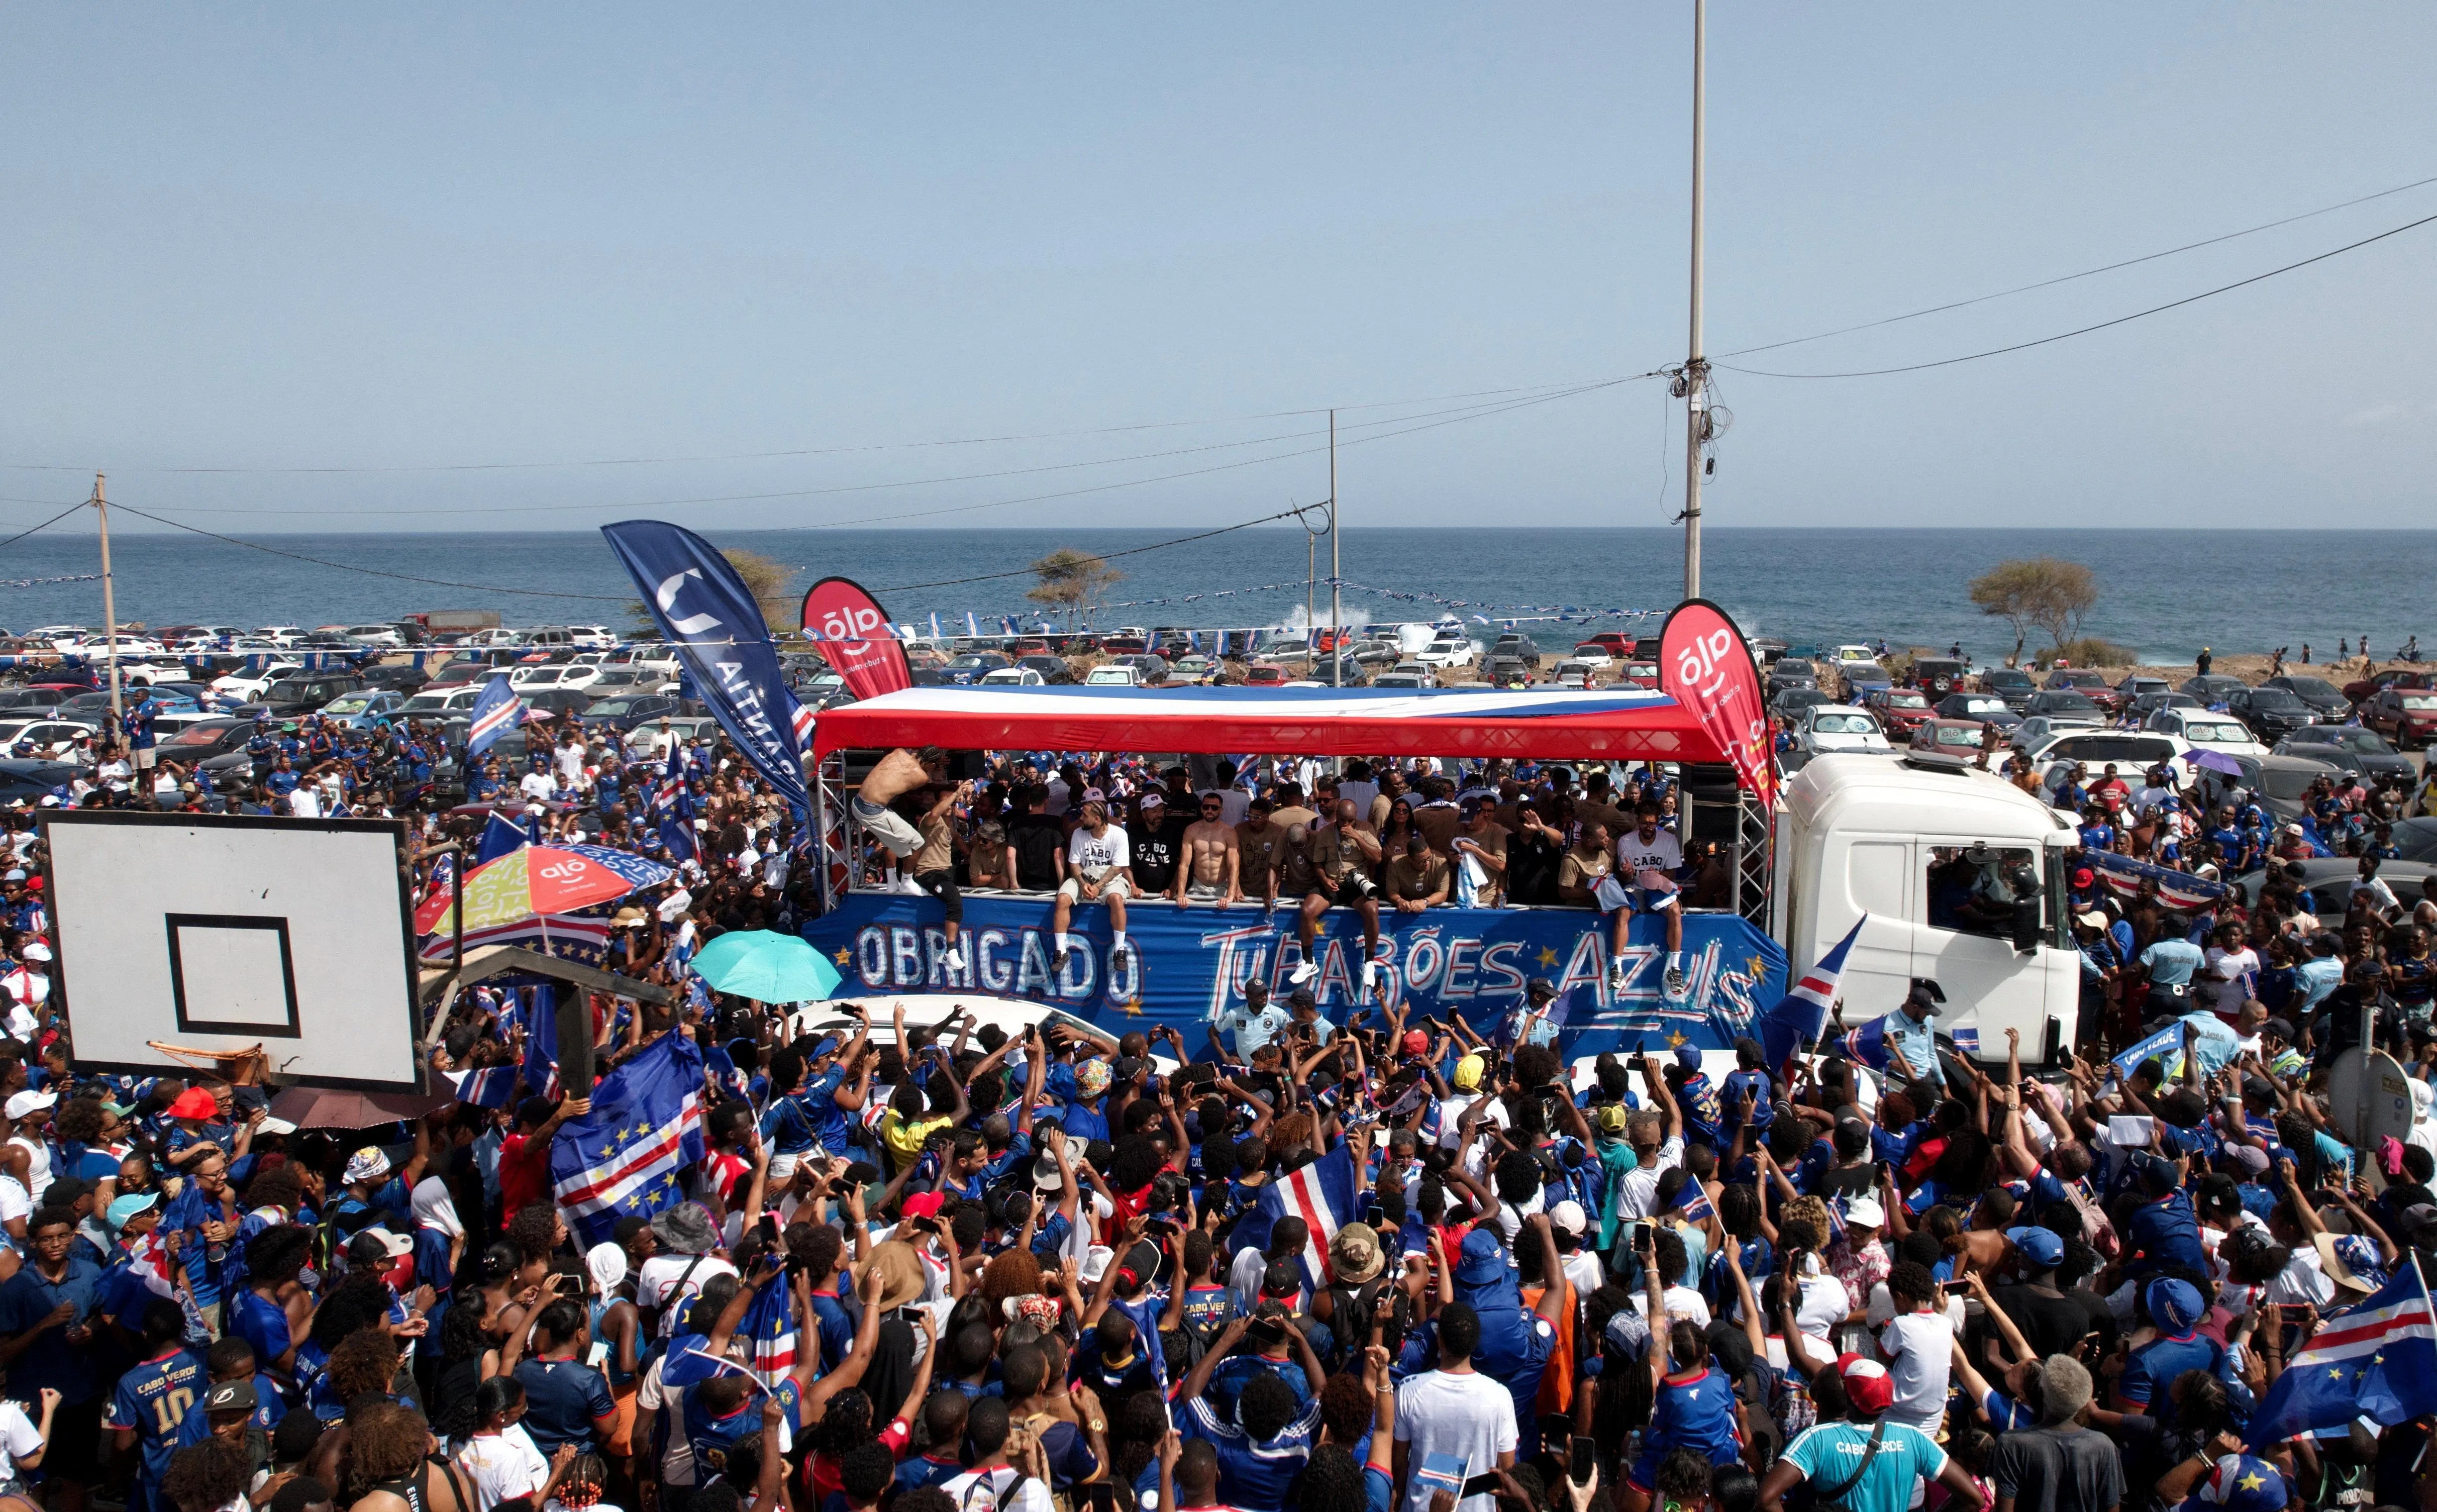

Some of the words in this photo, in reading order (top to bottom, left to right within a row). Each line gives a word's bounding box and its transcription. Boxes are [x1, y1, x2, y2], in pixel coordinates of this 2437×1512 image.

[1085, 848, 1110, 859] CABO
[1139, 843, 1167, 854] CBO
[1633, 856, 1663, 867] CABO
[857, 926, 1142, 1004] OBRIGADO
[1200, 924, 1527, 1022] TUBARÕES
[1559, 931, 1755, 1026] AZUIS
[2147, 1029, 2176, 1050] VERDE
[2200, 1029, 2225, 1043] LÍCIA
[137, 1377, 164, 1395] CABO
[152, 1387, 193, 1435] 10
[1837, 1441, 1866, 1454] CABO
[1878, 1440, 1905, 1452] ERDE
